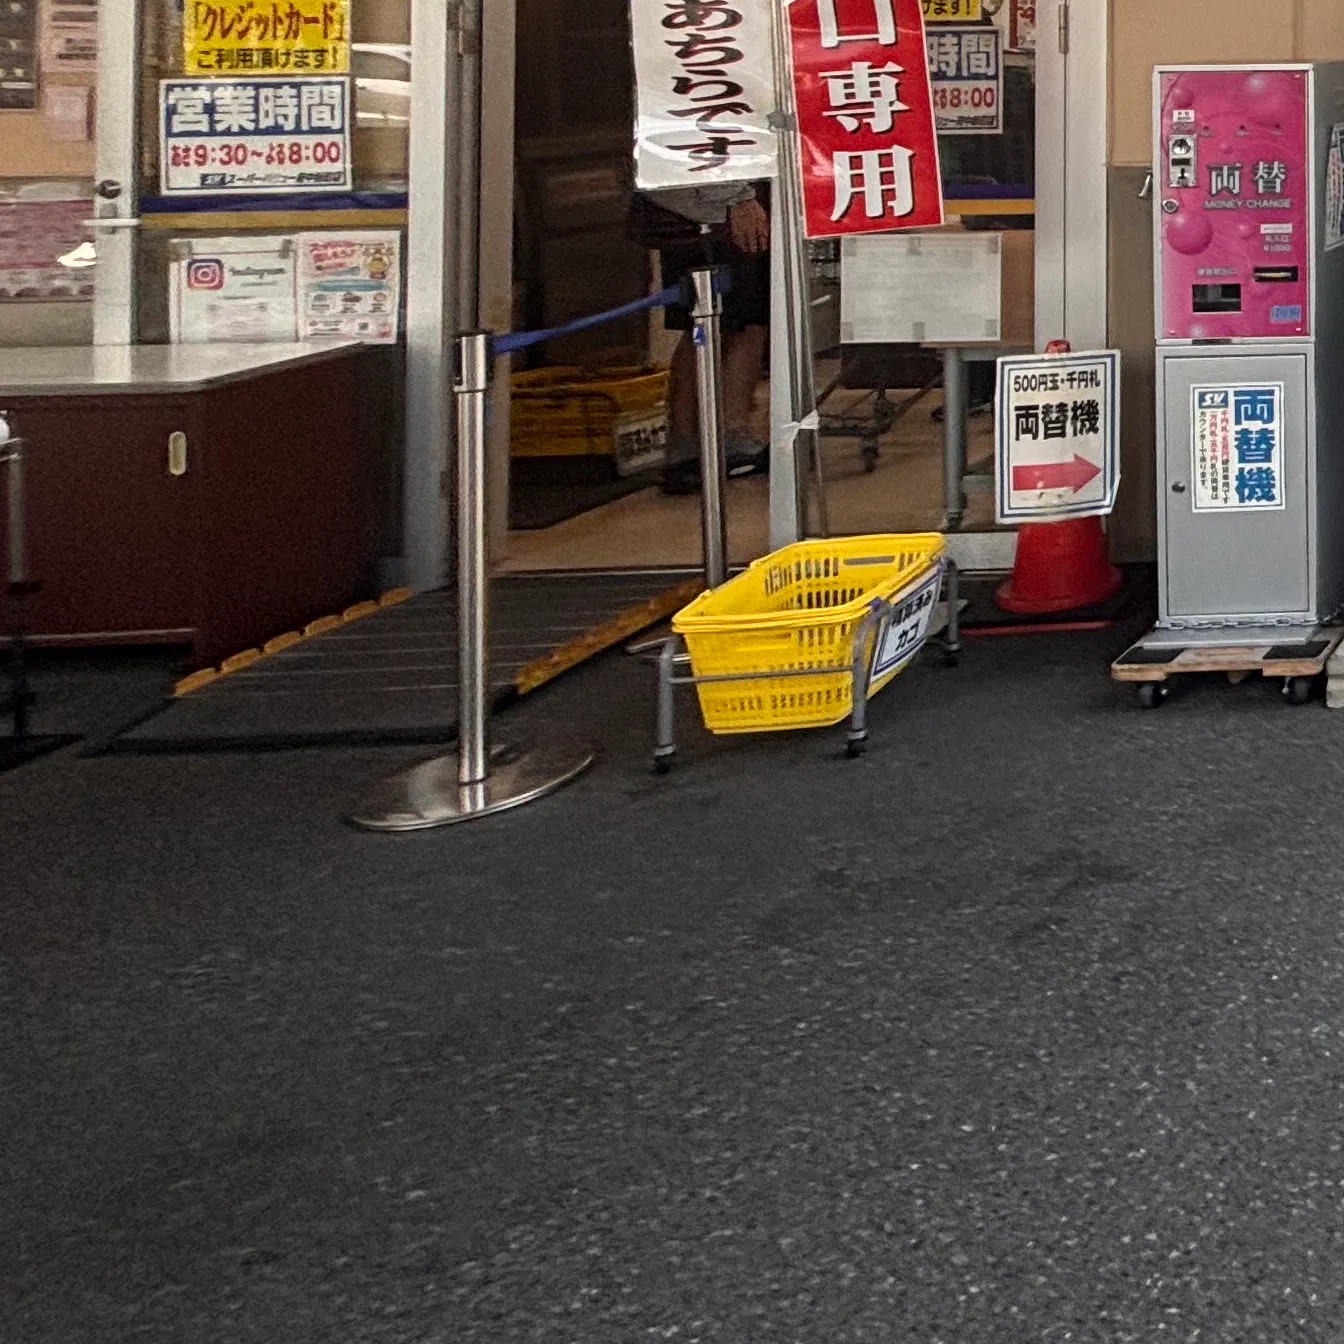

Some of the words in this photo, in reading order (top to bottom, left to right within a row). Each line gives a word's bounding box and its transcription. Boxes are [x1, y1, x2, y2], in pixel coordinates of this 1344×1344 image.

[194, 2, 345, 41] 「クレジットカード」
[197, 48, 338, 69] ご利用頂けます!
[927, 33, 997, 77] 時間
[168, 84, 343, 134] 営業時間
[1208, 160, 1287, 196] 両替
[1204, 200, 1243, 209] MONEY
[1247, 199, 1291, 209] CHANGE
[1013, 369, 1100, 393] 500円玉・千円札
[1013, 399, 1100, 442] 両替機
[1233, 389, 1276, 504] 両替機
